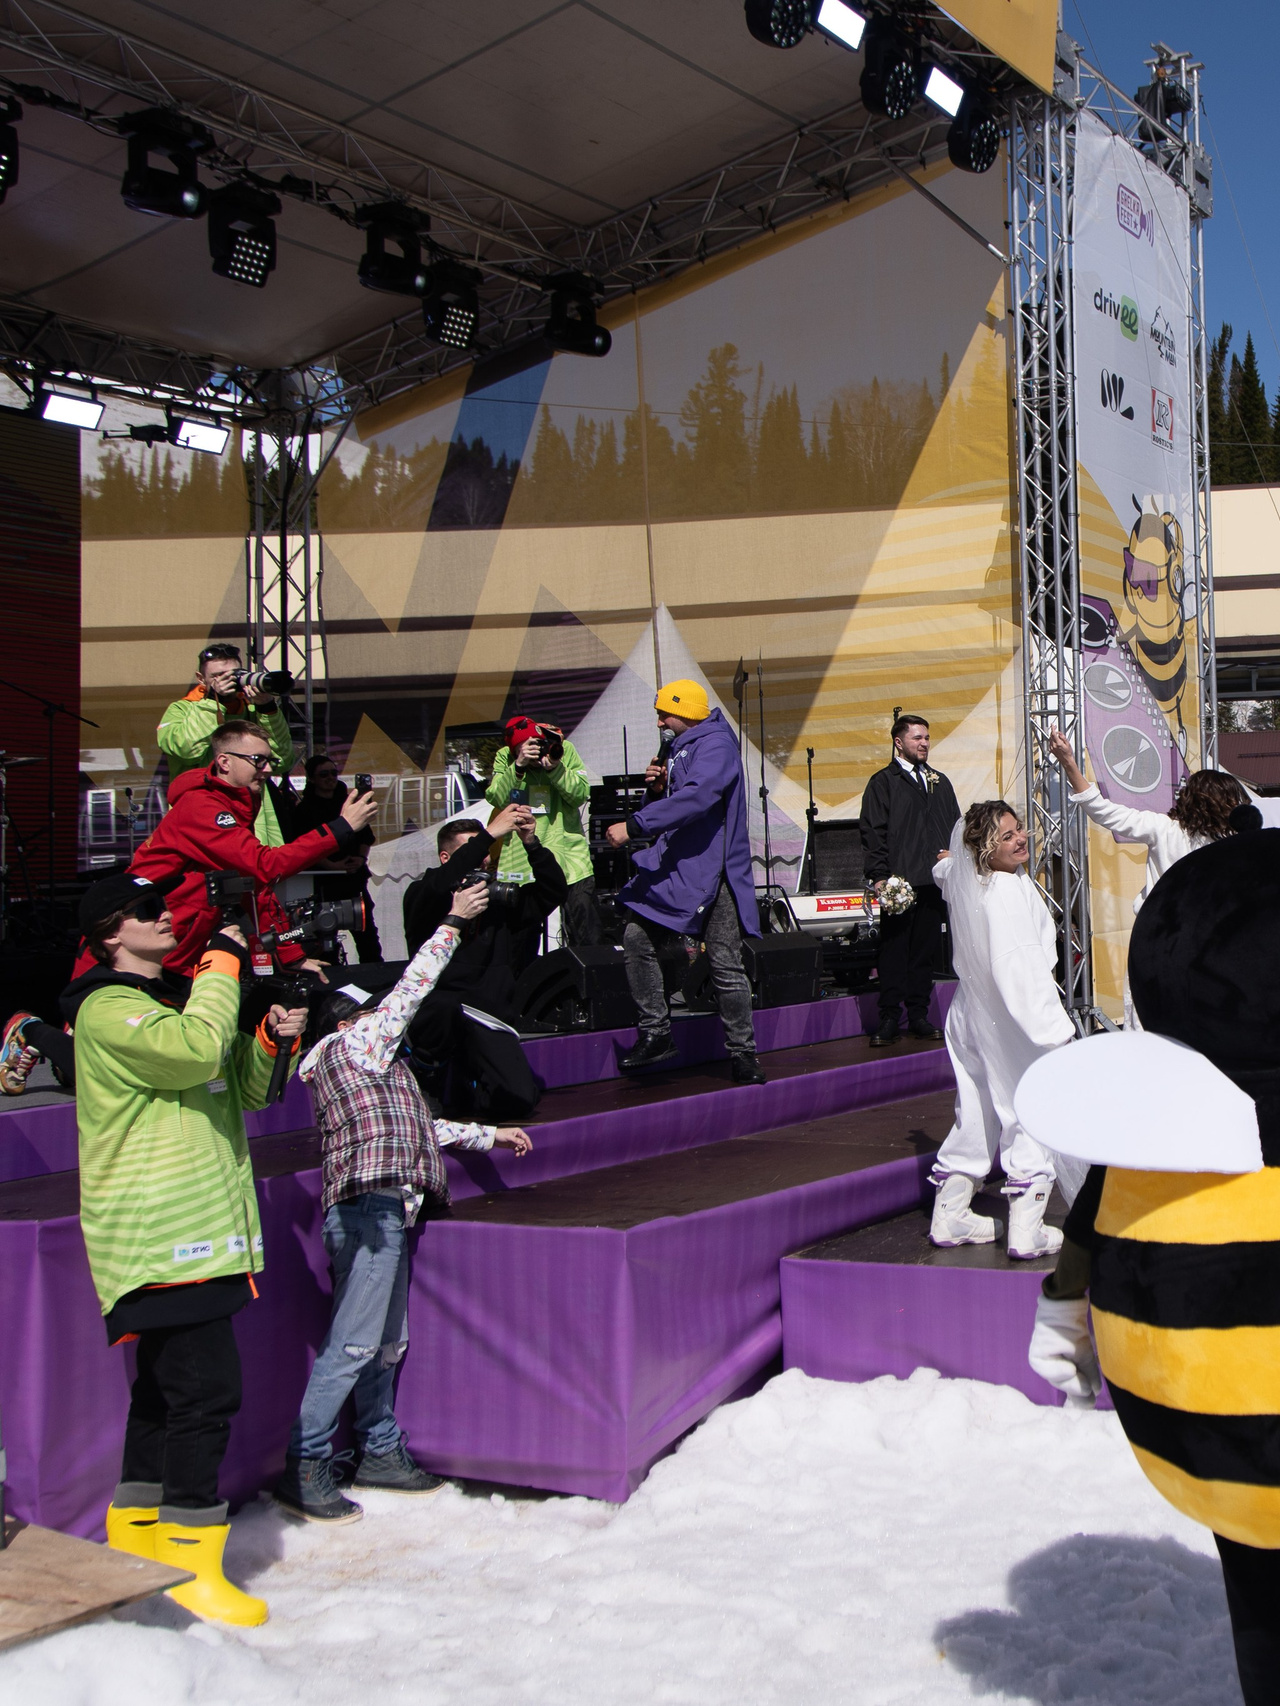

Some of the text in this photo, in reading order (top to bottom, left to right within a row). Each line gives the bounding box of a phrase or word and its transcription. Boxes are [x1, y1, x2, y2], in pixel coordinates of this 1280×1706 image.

[1121, 190, 1140, 217] GRELKA
[1121, 207, 1133, 228] FEST
[279, 928, 304, 942] RONIN
